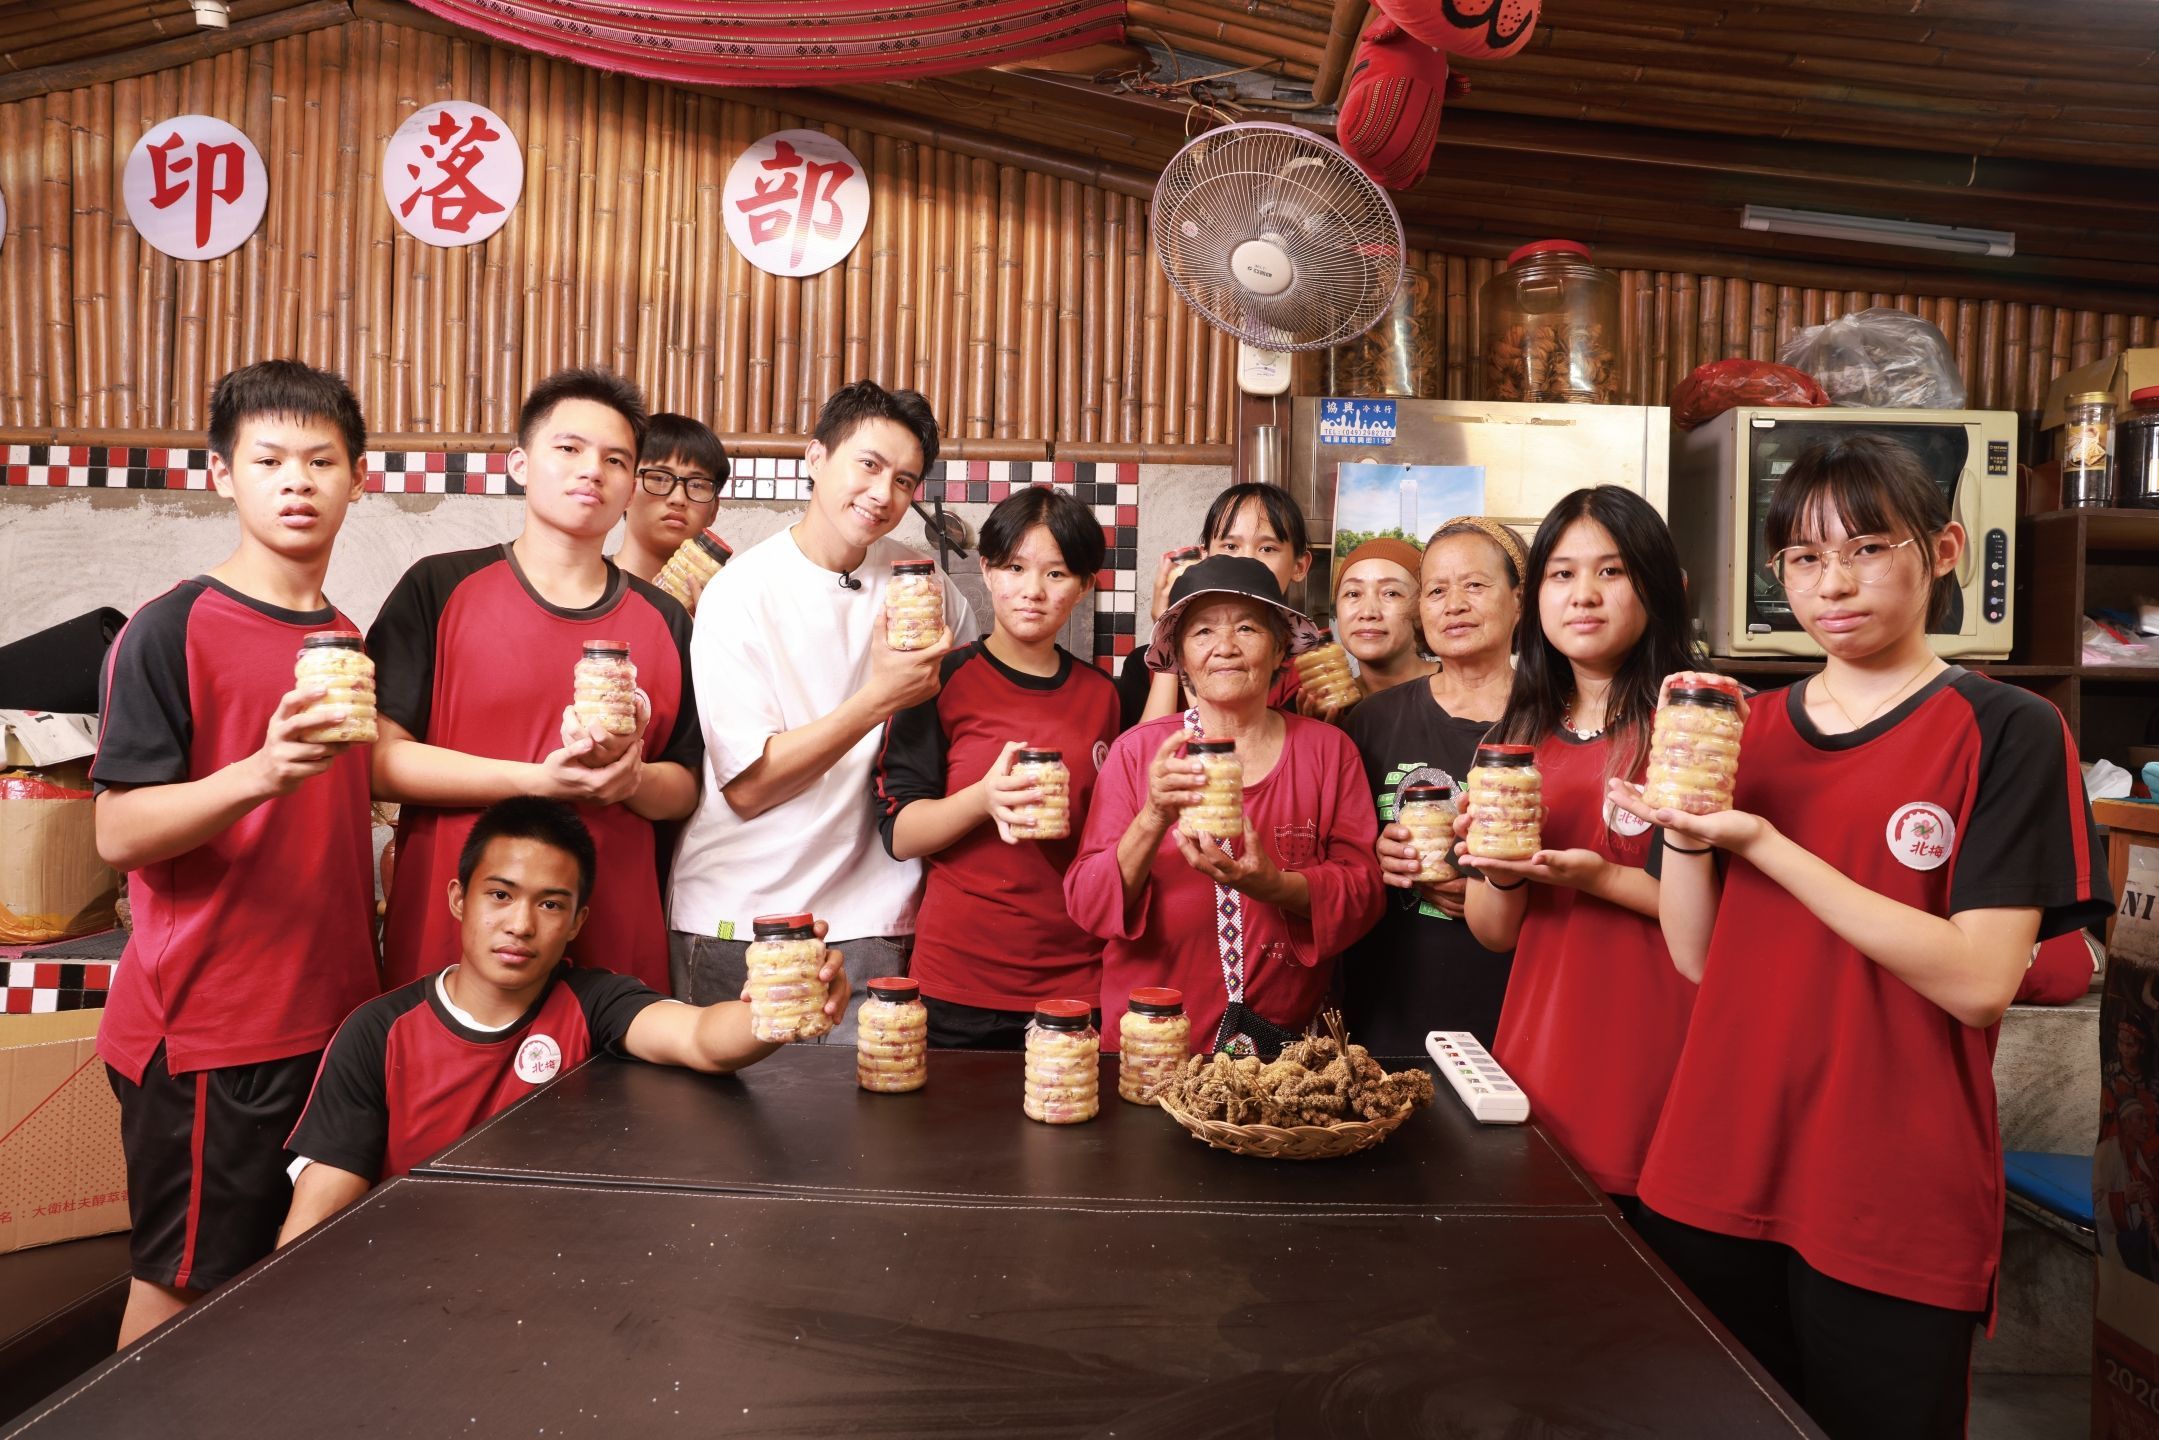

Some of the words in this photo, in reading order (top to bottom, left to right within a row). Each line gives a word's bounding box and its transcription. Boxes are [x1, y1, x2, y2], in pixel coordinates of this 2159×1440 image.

[146, 131, 246, 249] 印
[399, 111, 506, 234] 落
[735, 139, 855, 269] 部
[1909, 841, 1944, 858] 北梅
[531, 1060, 556, 1074] 北梅
